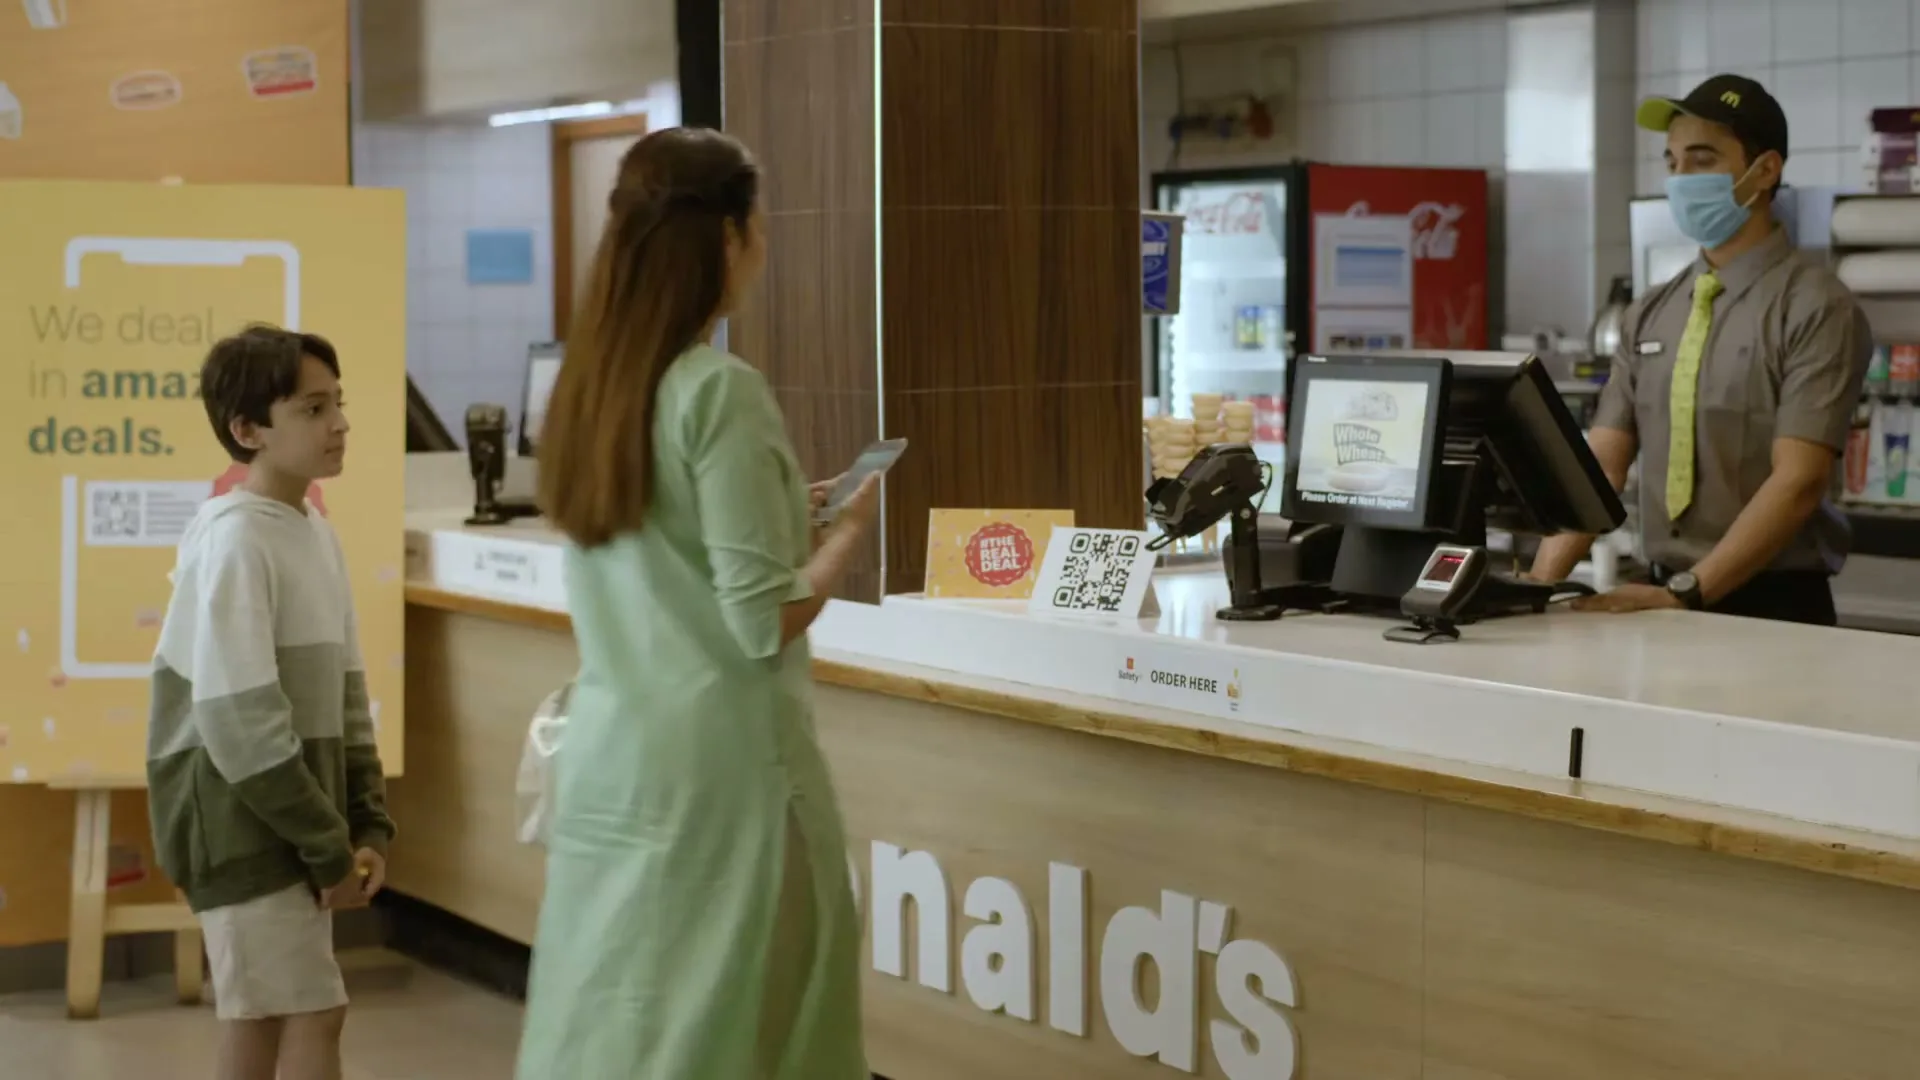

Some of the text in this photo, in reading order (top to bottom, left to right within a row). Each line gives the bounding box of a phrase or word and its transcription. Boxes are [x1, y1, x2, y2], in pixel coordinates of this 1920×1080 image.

[29, 304, 217, 346] We deal
[29, 360, 67, 399] in
[29, 416, 175, 456] deals.
[1335, 425, 1379, 443] Whole
[1302, 491, 1408, 511] Please Order at Next Register
[980, 536, 1015, 549] #THE
[980, 546, 1020, 561] REAL
[981, 557, 1021, 572] DEAL
[1151, 670, 1187, 688] ORDER
[1189, 676, 1217, 693] HERE
[846, 838, 1298, 1080] nald's
